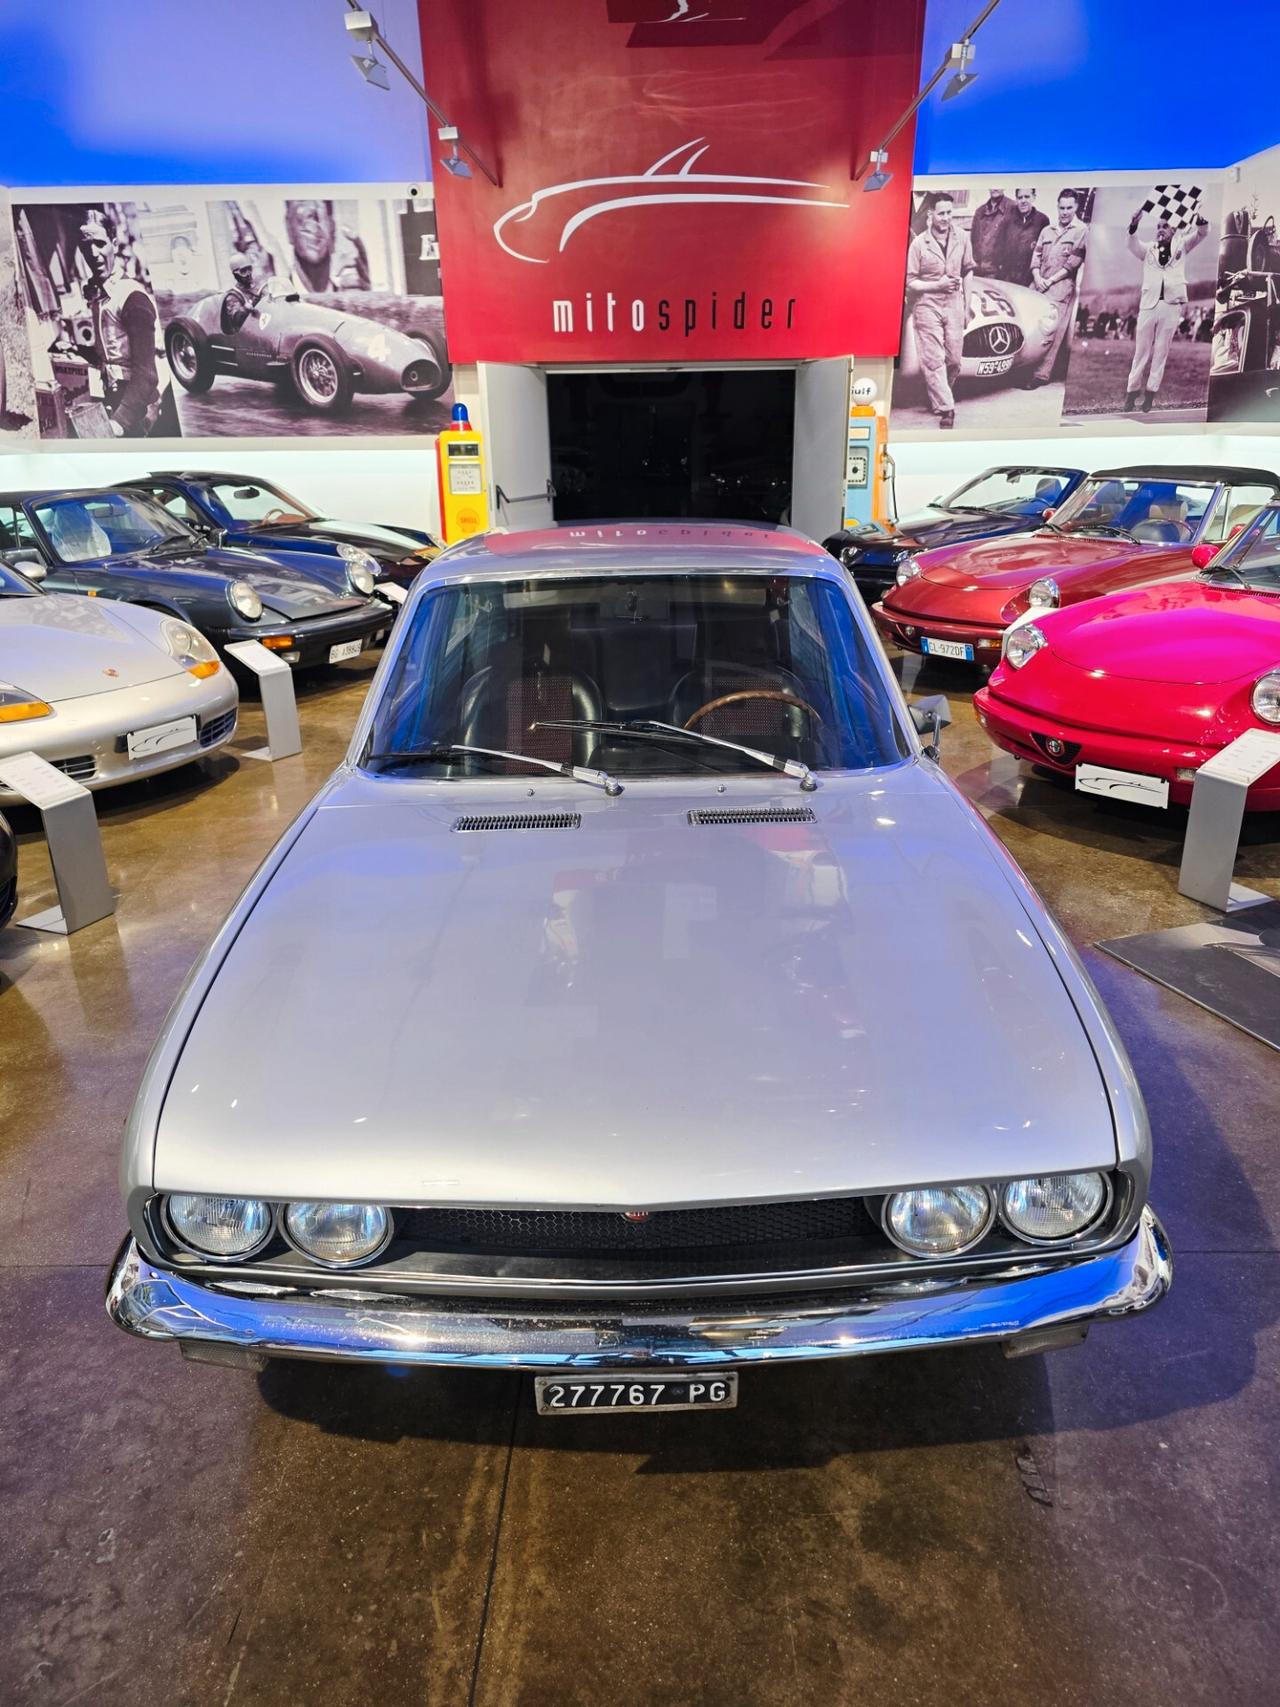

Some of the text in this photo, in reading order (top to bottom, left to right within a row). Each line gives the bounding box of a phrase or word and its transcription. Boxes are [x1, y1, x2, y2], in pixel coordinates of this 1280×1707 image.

[851, 386, 871, 395] ulf
[549, 1382, 725, 1407] 277767 PG
